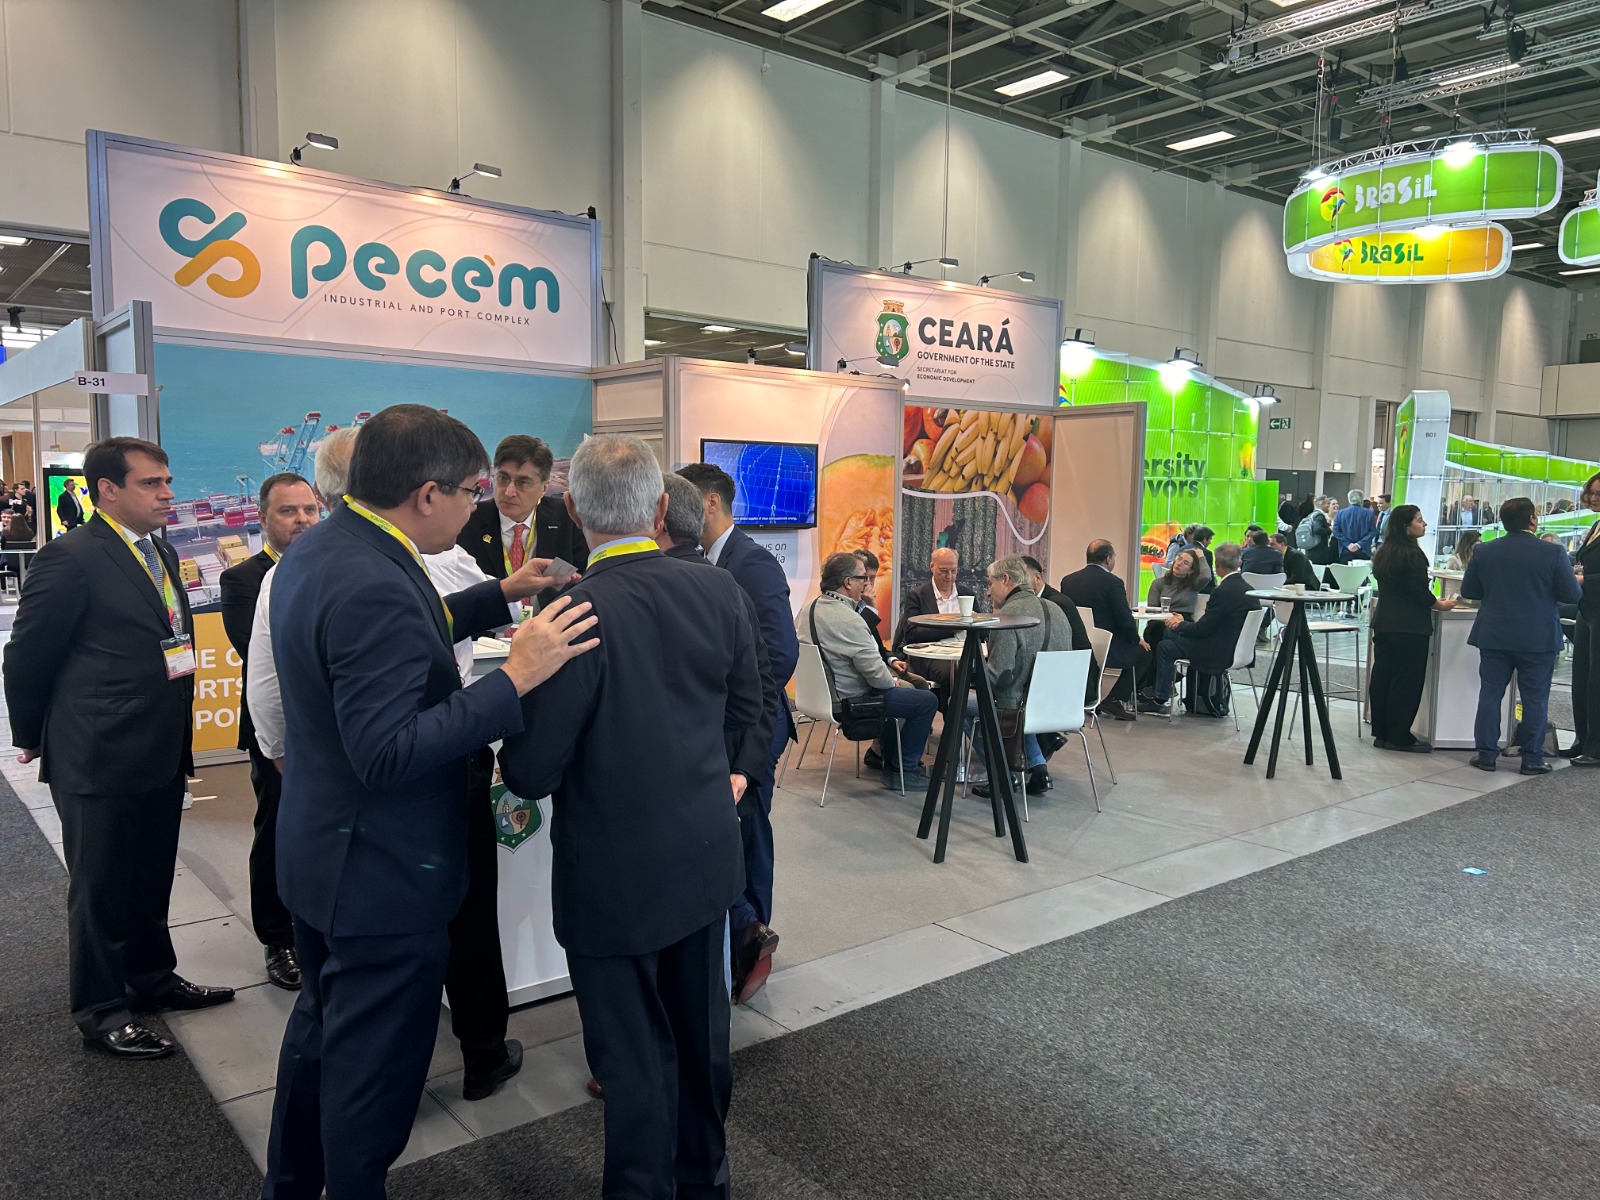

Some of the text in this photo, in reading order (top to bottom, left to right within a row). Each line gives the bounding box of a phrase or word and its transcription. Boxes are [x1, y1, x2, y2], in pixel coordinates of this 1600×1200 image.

[324, 293, 530, 325] INDUSTRIAL AND PORT COMPLEX
[918, 316, 1014, 355] CEARÁ
[917, 351, 1015, 369] GOVERNMENT OF THE STATE
[78, 376, 105, 387] B-31
[775, 543, 787, 551] on
